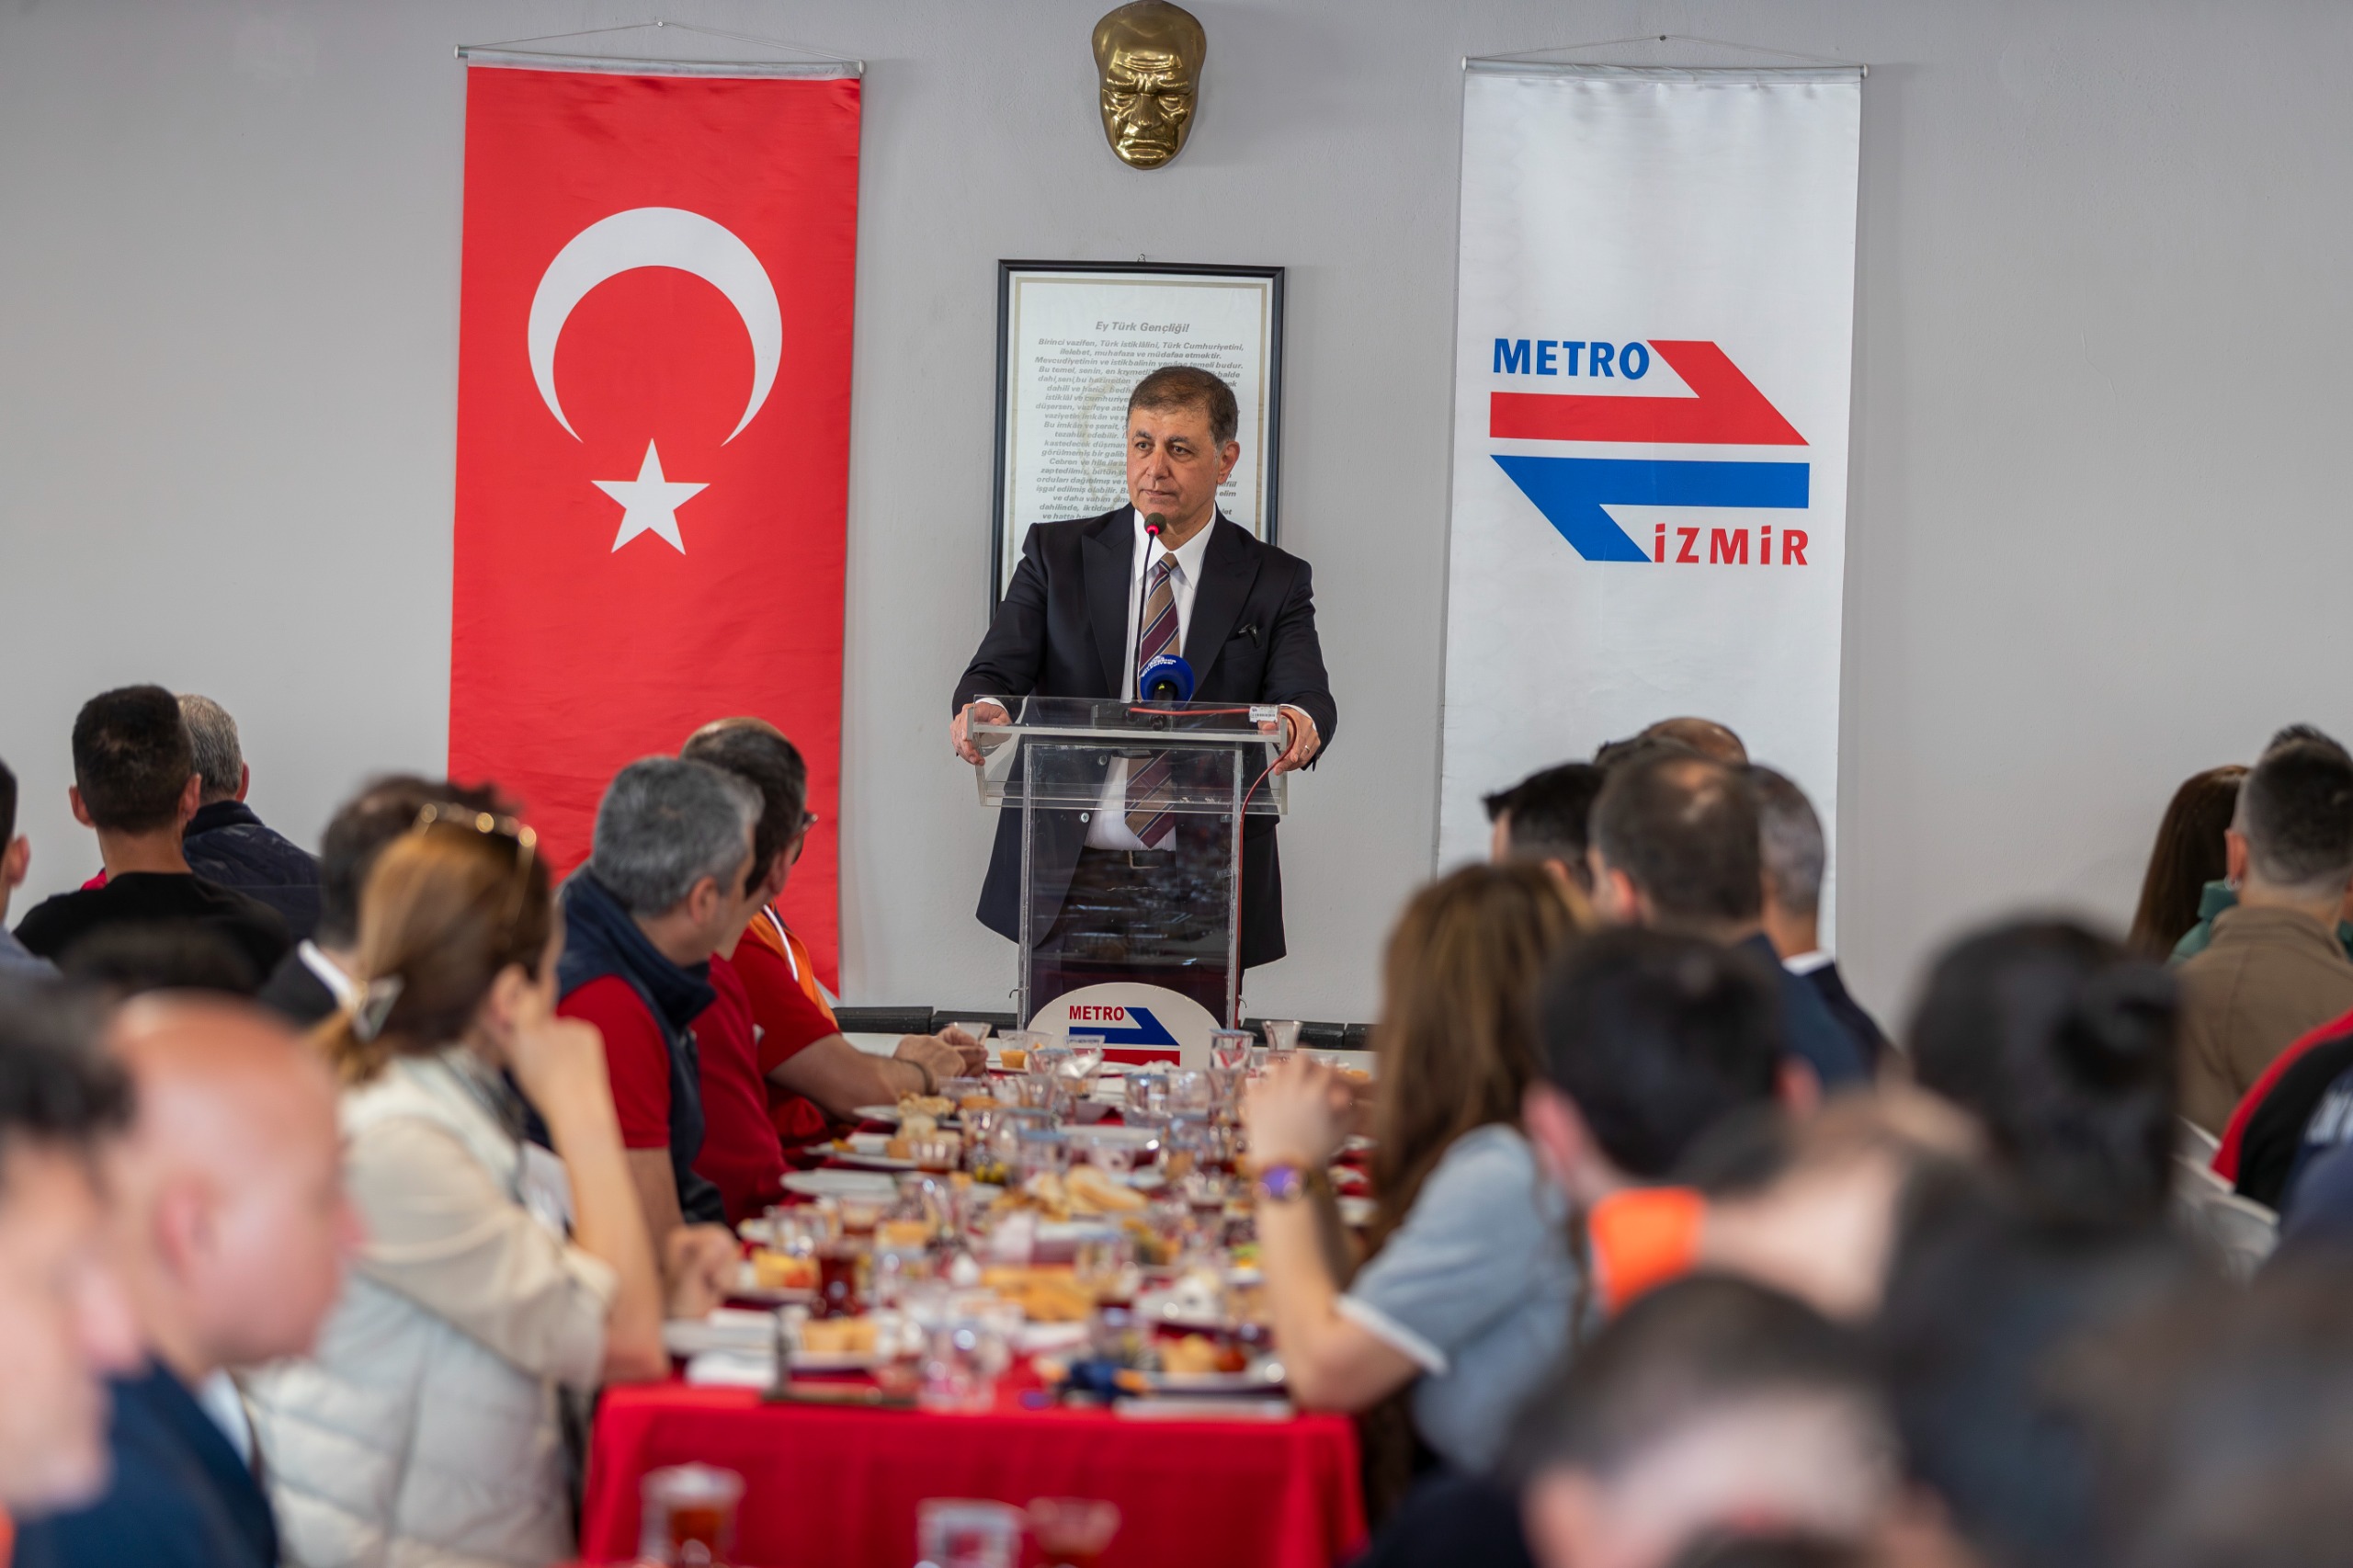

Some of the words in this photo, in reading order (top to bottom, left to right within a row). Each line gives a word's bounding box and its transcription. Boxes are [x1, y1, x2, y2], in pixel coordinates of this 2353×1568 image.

[1096, 322, 1108, 332] Ey
[1112, 322, 1137, 331] Türk
[1141, 323, 1190, 334] Gençliği!
[1067, 339, 1097, 347] vazifen,
[1184, 343, 1244, 351] Cumhuriyetini,
[1060, 348, 1092, 357] ilelebet,
[1035, 357, 1097, 365] Mevcudiyetinin
[1493, 338, 1650, 381] METRO
[1654, 523, 1809, 566] İZMİR
[1069, 1006, 1125, 1021] METRO
